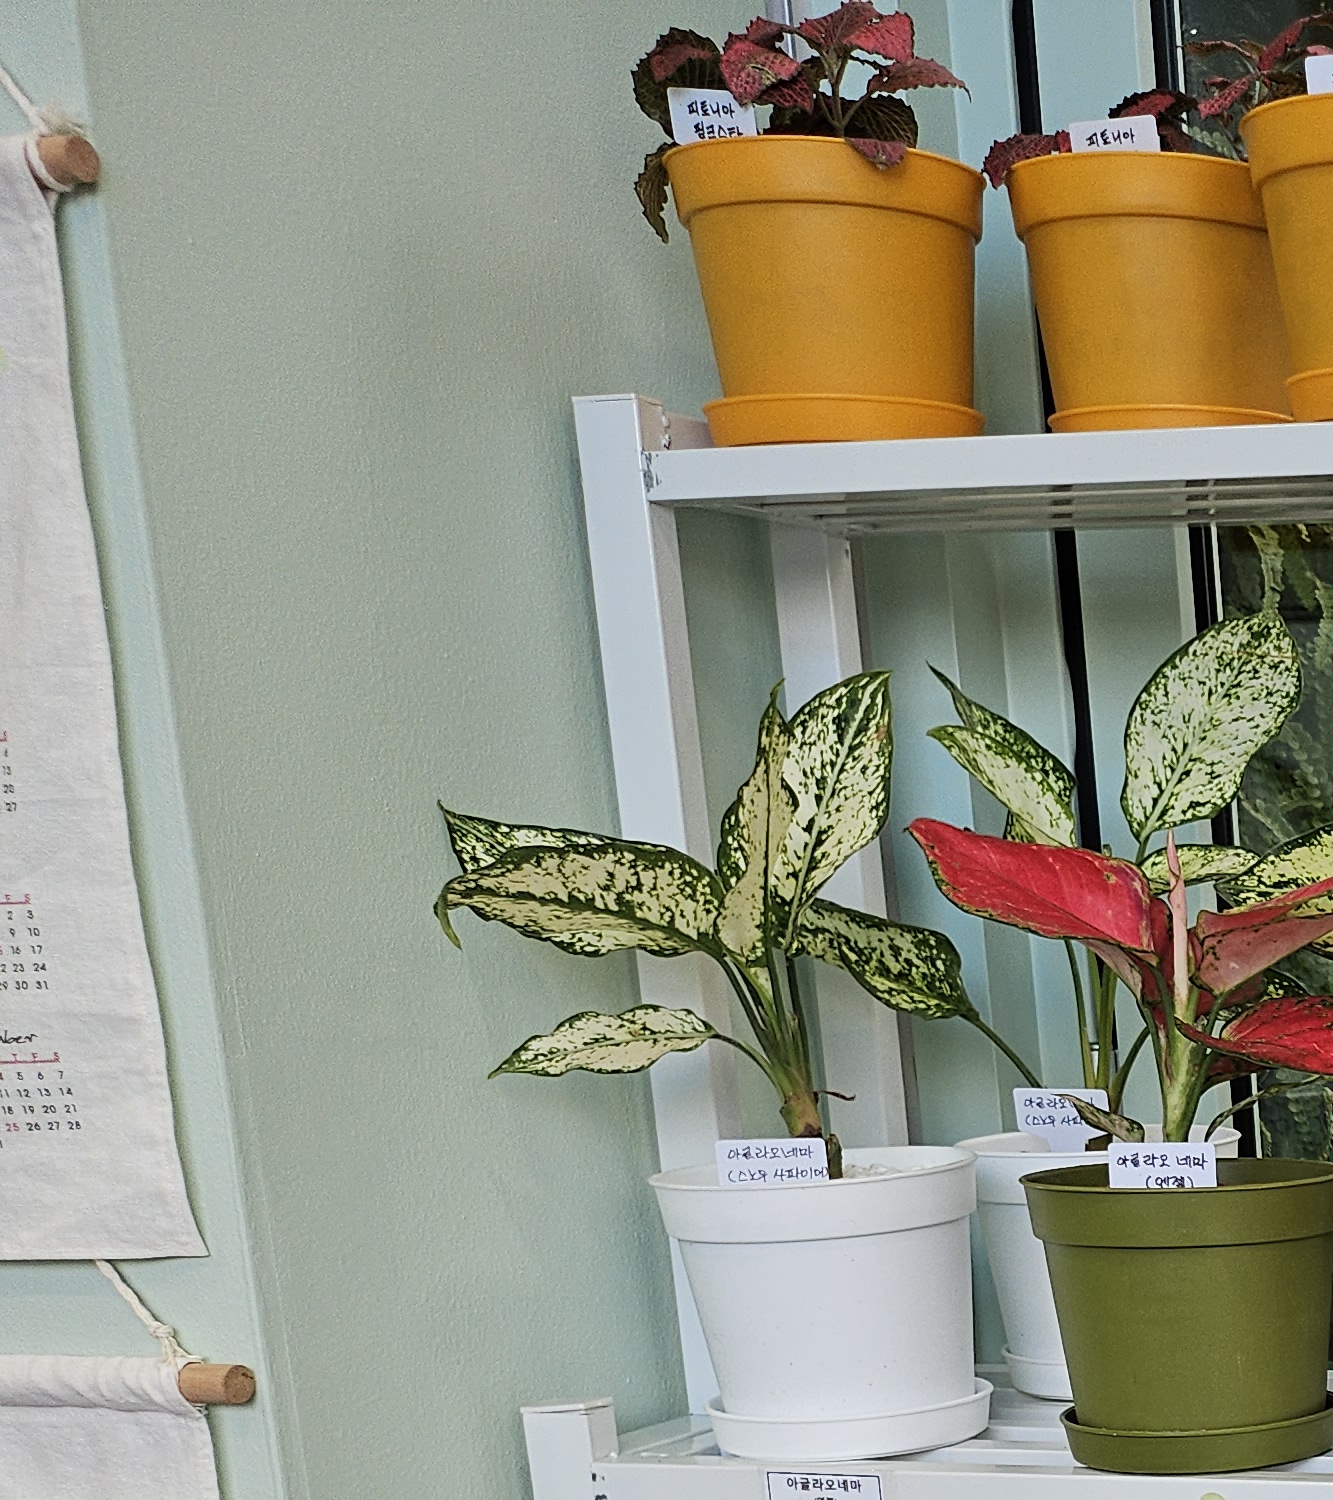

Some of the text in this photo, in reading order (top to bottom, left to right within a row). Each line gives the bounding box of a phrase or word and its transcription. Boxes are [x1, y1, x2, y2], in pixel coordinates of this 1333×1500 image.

[687, 99, 736, 120] 피토니아
[693, 121, 744, 140] 핑크스타
[1086, 129, 1137, 148] 피토니아
[7, 910, 34, 920] 2 3
[27, 927, 40, 937] 10
[10, 945, 43, 955] 16 17
[12, 962, 47, 973] 23 24
[15, 981, 49, 991] 30 31
[16, 1070, 64, 1081] 5 6 7
[16, 1088, 31, 1099] 12
[37, 1087, 51, 1097] 13
[58, 1086, 73, 1097] 14
[1, 1104, 77, 1115] 18 19 20 21
[5, 1122, 20, 1132] 25
[25, 1121, 41, 1132] 26
[47, 1121, 60, 1131] 27
[728, 1146, 813, 1161] 아글라오네마
[786, 1477, 862, 1494] 아글라오네마
